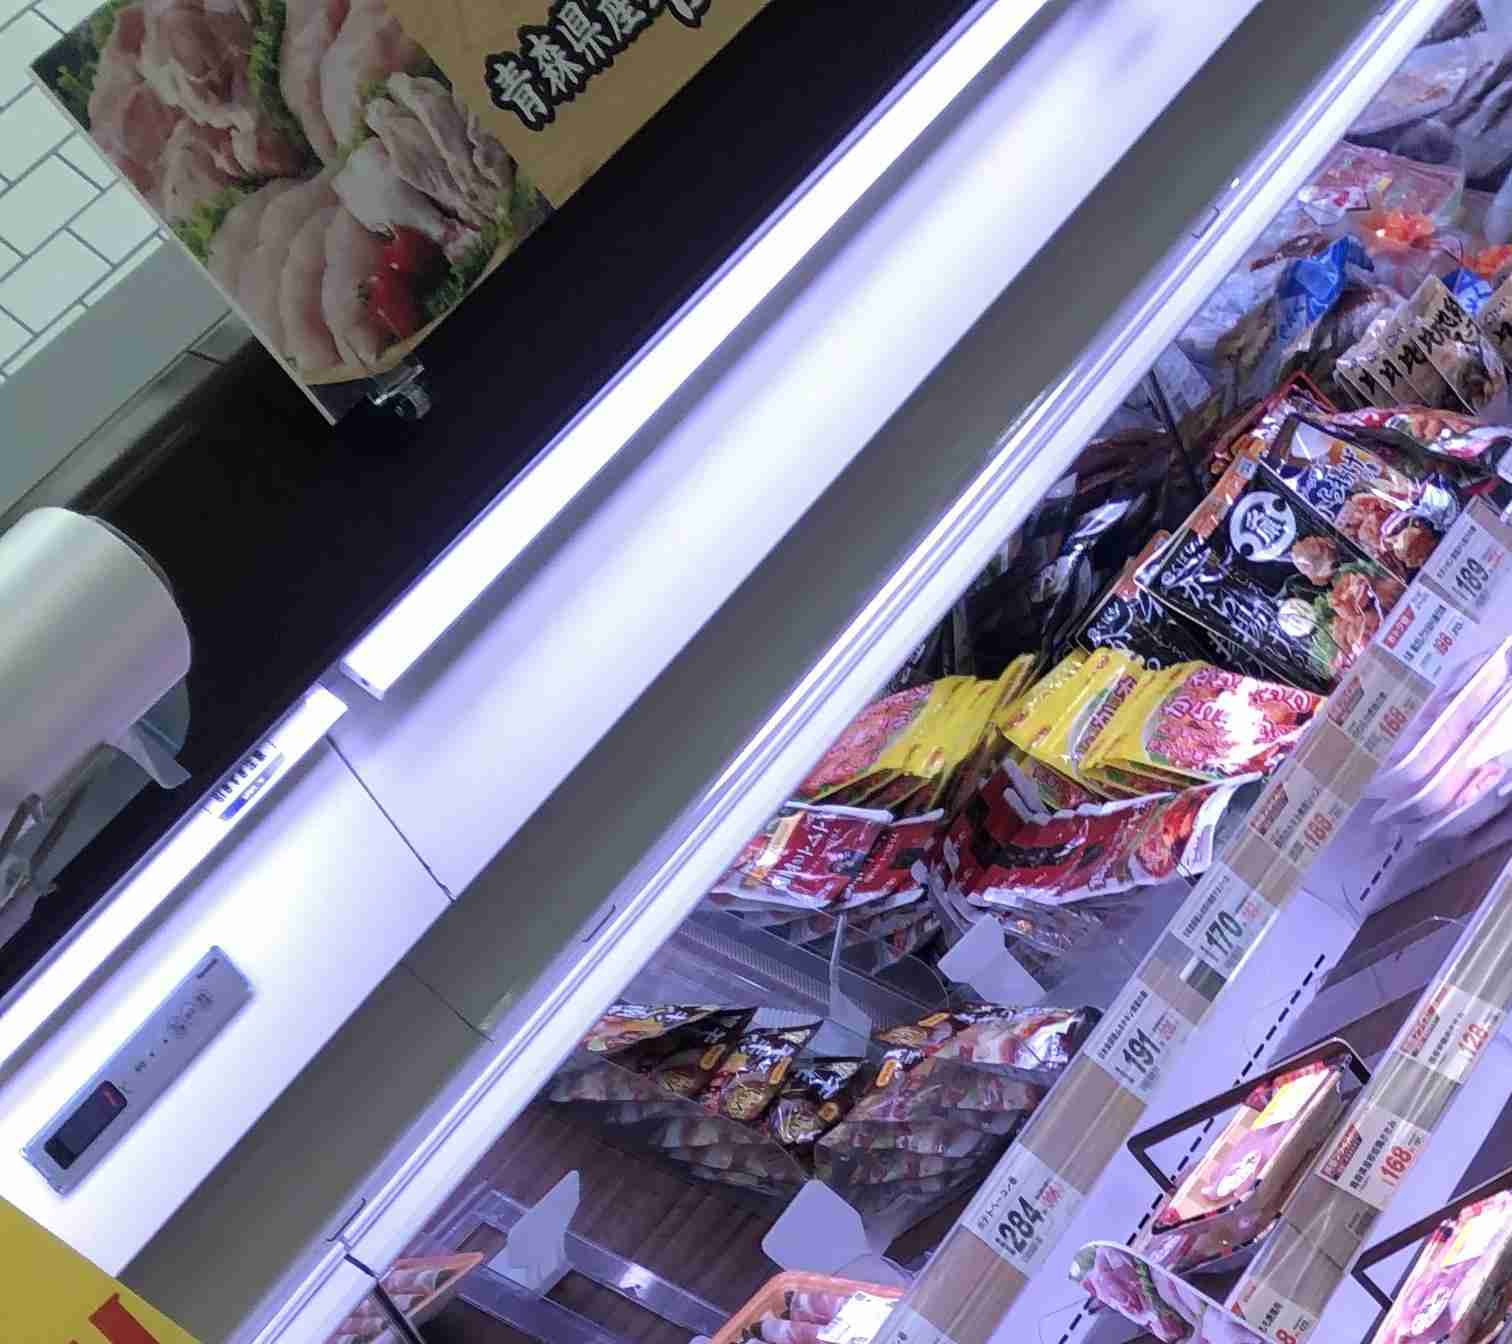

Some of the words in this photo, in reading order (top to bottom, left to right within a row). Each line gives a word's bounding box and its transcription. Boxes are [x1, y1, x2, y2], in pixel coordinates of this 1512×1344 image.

[1451, 556, 1493, 599] 189
[1200, 908, 1247, 956] 170
[1118, 1026, 1165, 1075] 191
[1377, 1143, 1414, 1182] 168
[993, 1194, 1048, 1254] 284
